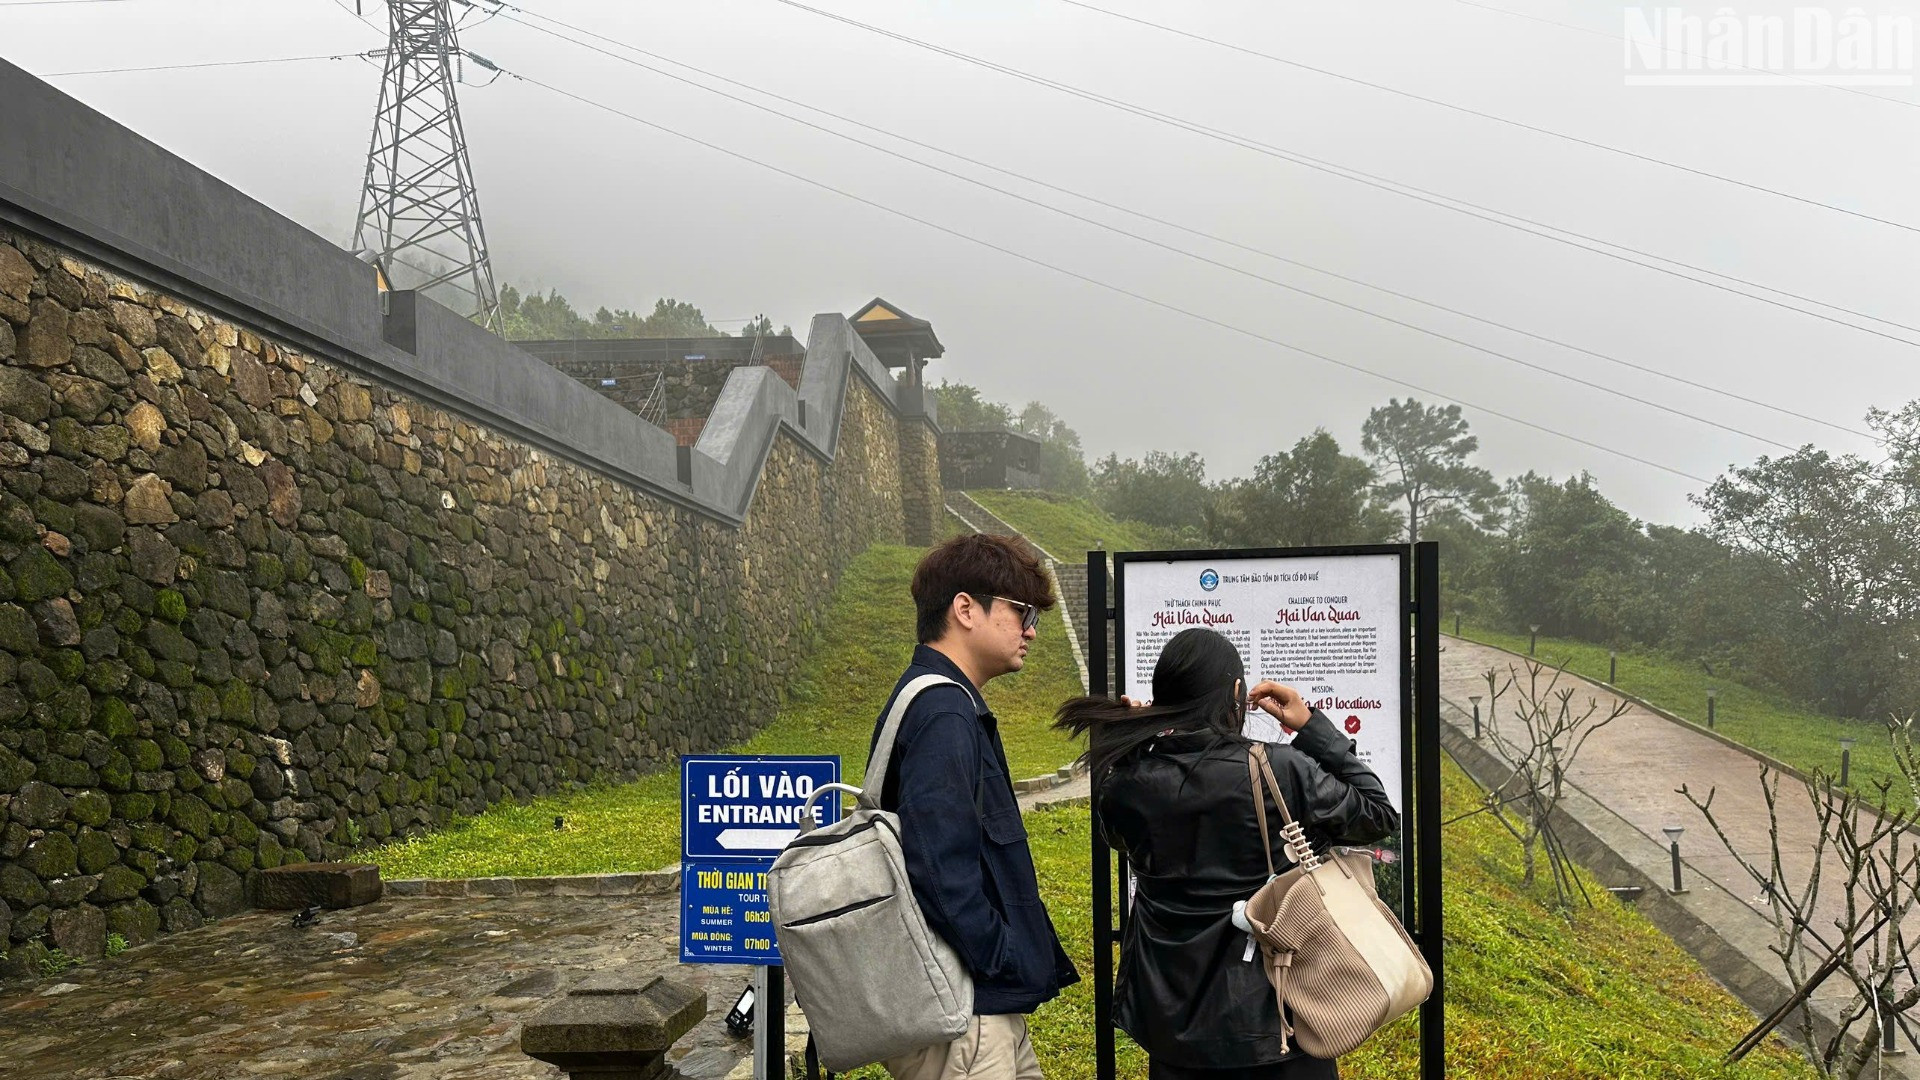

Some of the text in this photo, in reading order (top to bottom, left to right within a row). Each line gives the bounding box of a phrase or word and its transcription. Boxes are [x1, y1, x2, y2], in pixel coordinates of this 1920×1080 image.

[1288, 595, 1348, 605] CHALLENGE TO CONQUER
[1152, 608, 1234, 628] Hải Vân Quan
[1275, 605, 1361, 626] Hai Van Quan
[1326, 697, 1333, 709] 9
[1335, 696, 1382, 709] locations
[708, 767, 814, 799] LỐI VÀO
[698, 804, 824, 824] ENTRANCE
[697, 867, 722, 889] THỜI
[726, 872, 754, 889] GIAN
[739, 894, 760, 902] TOUR
[701, 918, 733, 926] SUMMER
[745, 911, 770, 922] 06h30
[745, 938, 770, 950] 07h00
